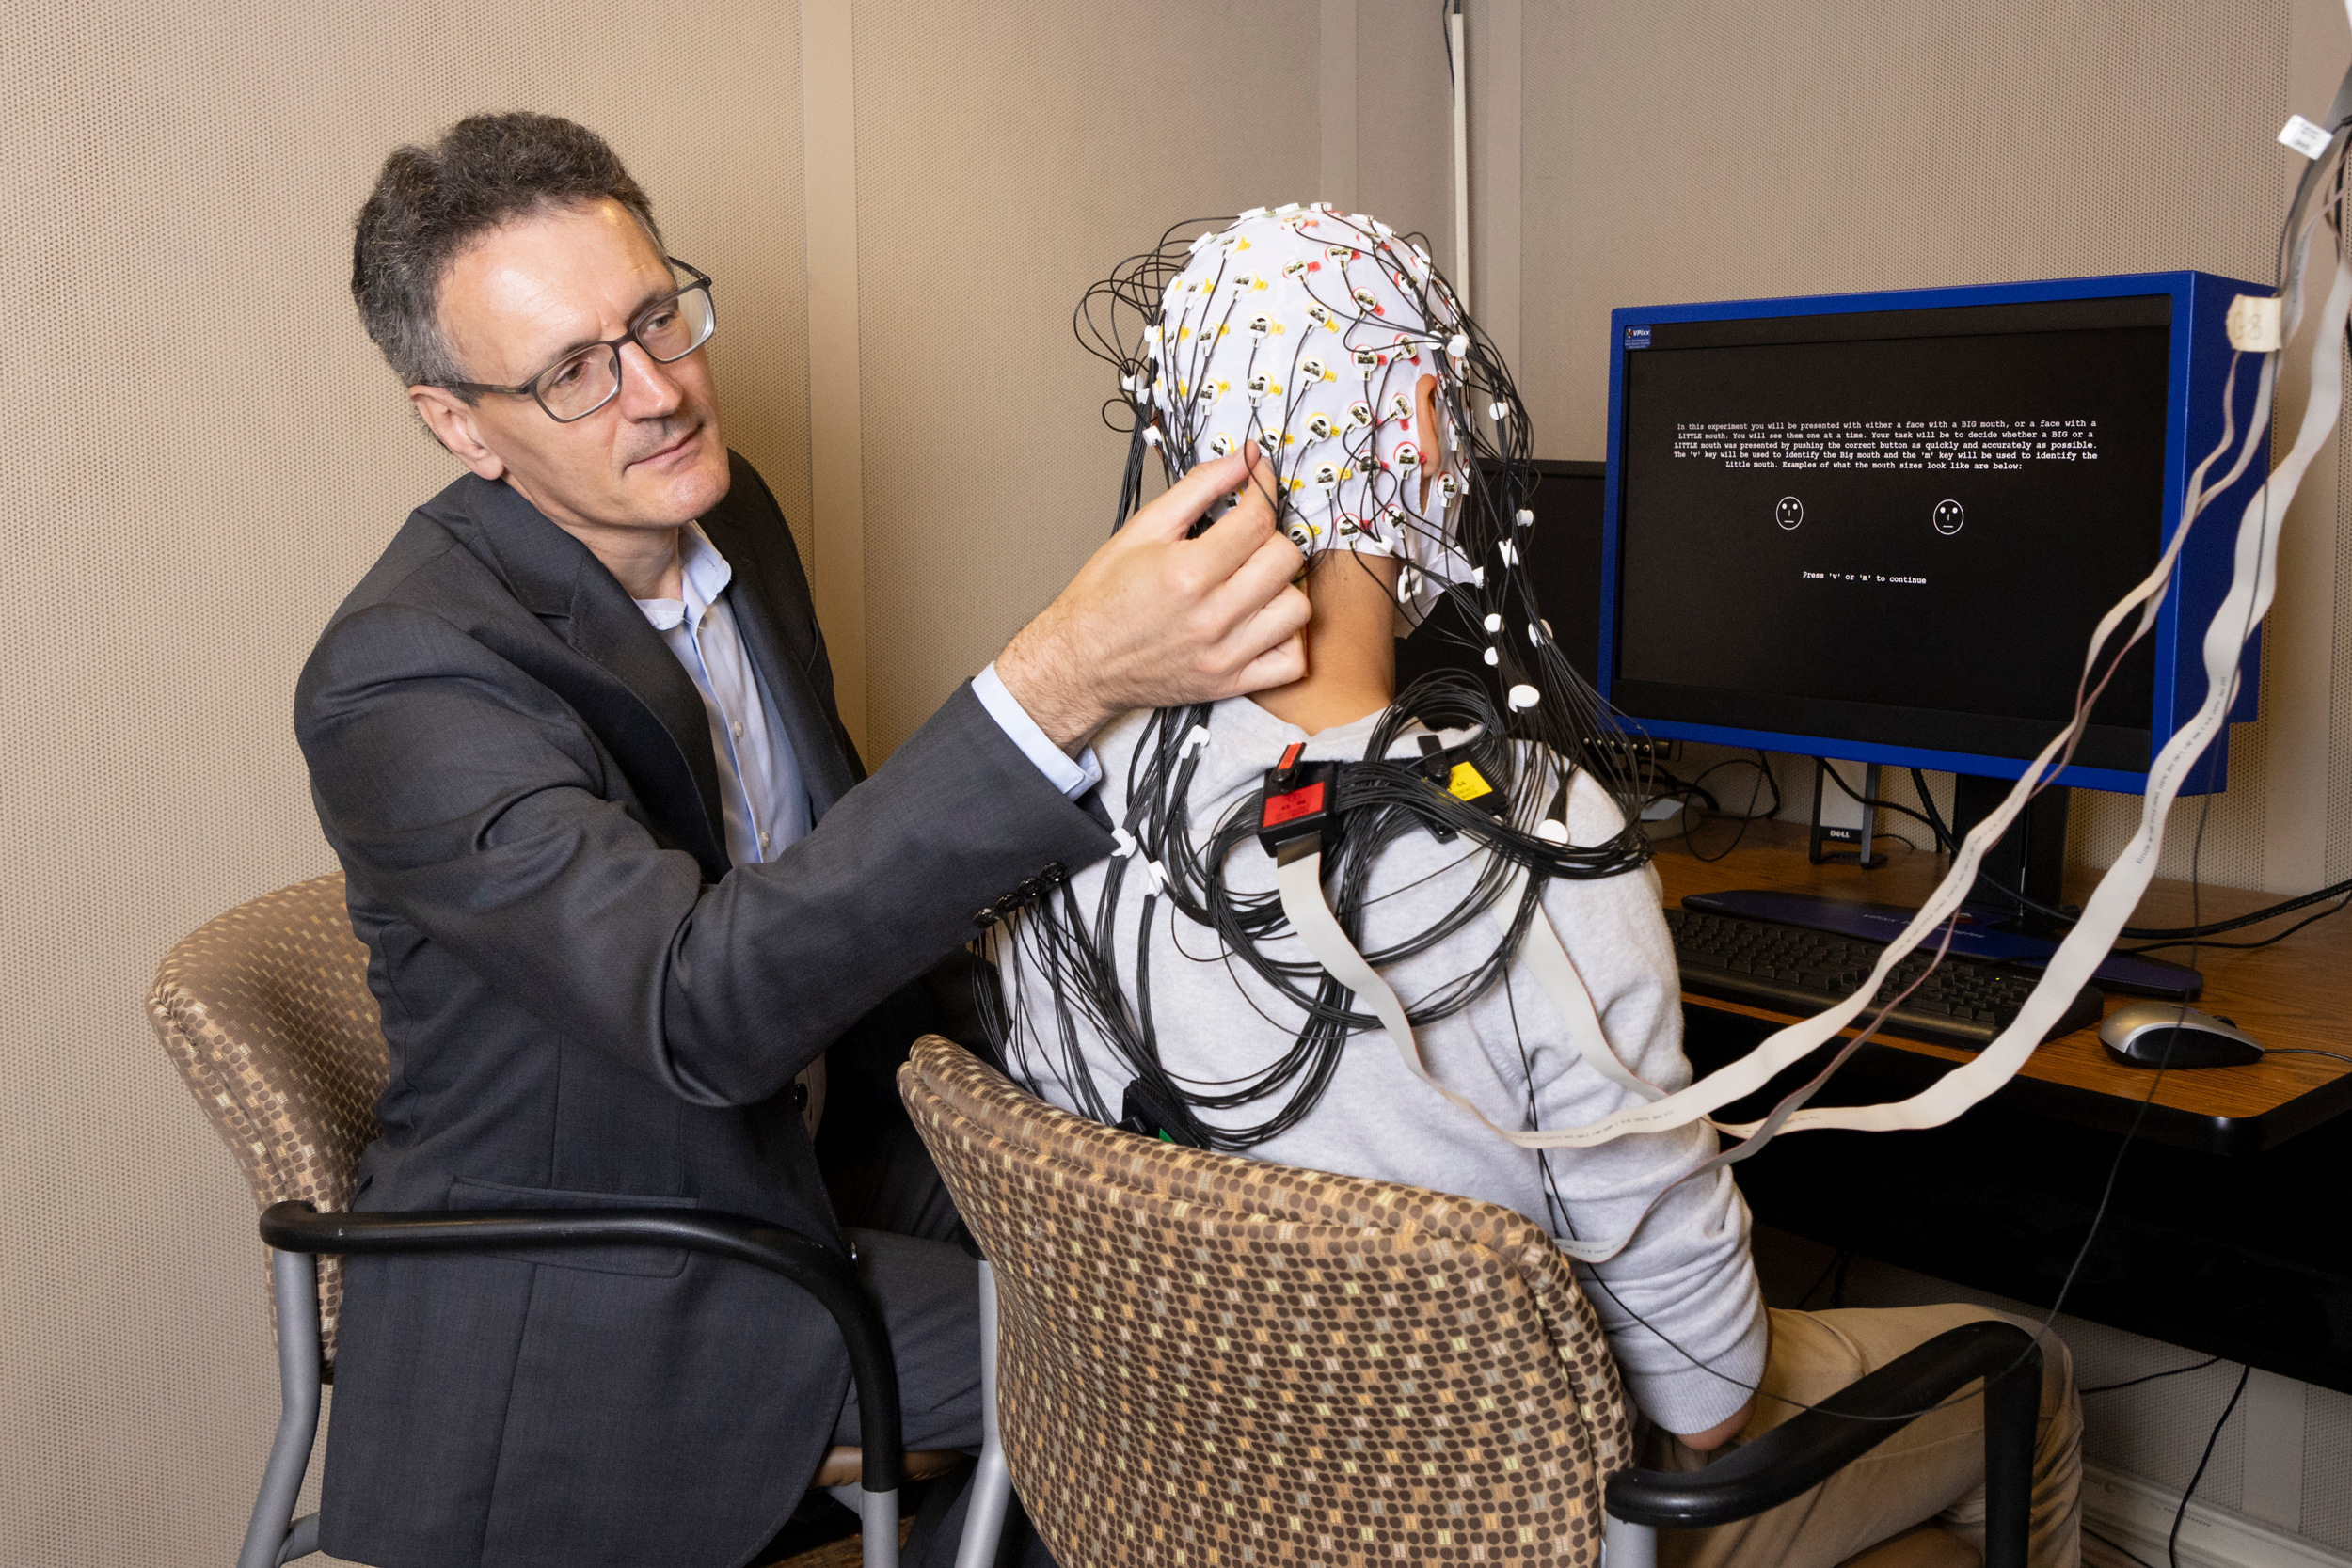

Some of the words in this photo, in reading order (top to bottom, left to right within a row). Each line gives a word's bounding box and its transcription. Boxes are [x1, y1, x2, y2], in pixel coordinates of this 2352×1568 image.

[1925, 441, 1959, 450] quickly
[1982, 441, 2032, 450] accurately
[2051, 441, 2096, 450] possible.
[1785, 451, 1819, 460] identify
[1840, 452, 1854, 460] Big
[1939, 452, 1953, 460] key
[2036, 452, 2077, 461] identify
[1783, 461, 1816, 470] Examples
[1830, 830, 1850, 839] DELL
